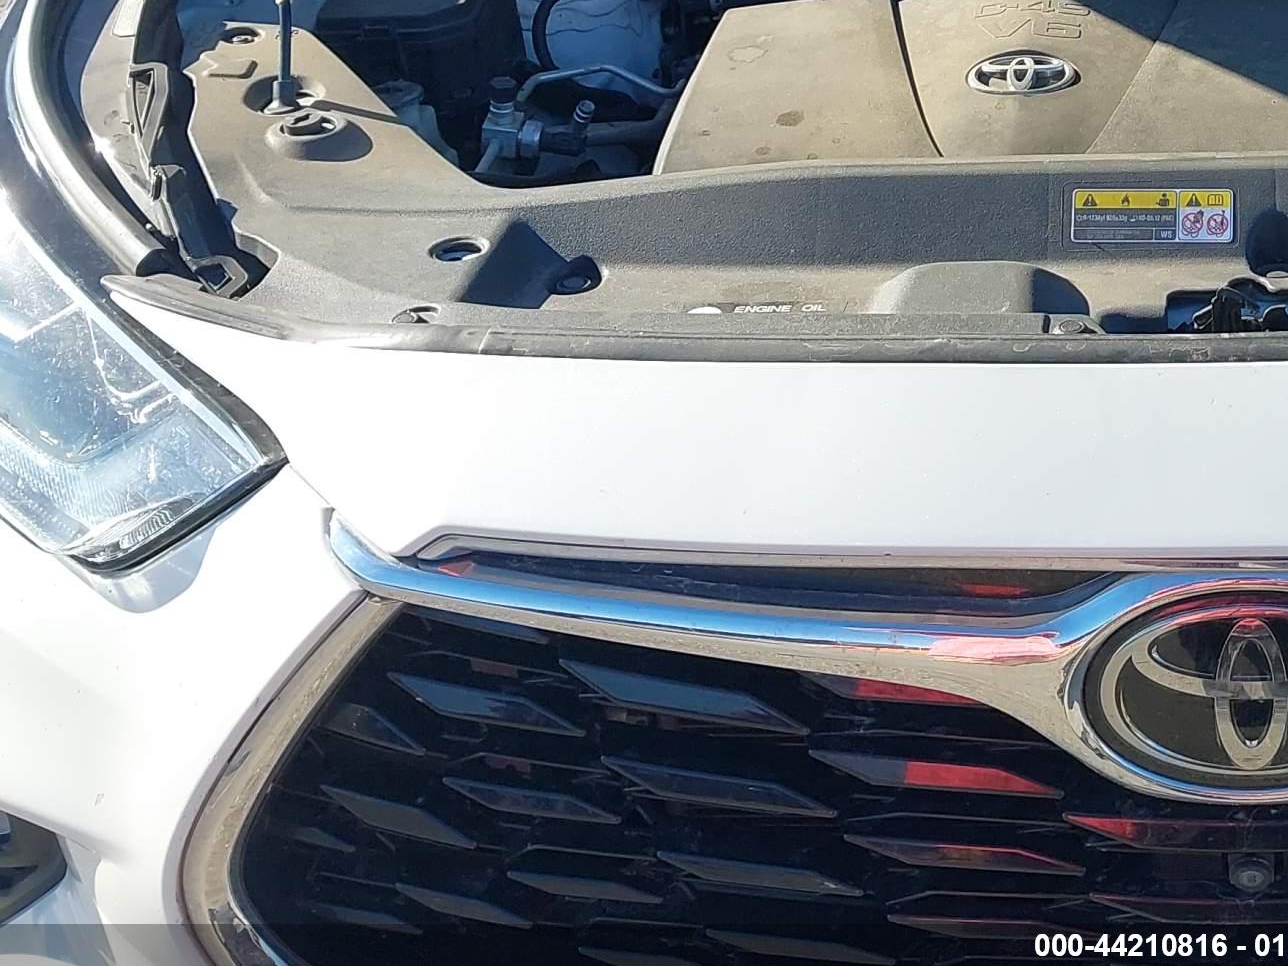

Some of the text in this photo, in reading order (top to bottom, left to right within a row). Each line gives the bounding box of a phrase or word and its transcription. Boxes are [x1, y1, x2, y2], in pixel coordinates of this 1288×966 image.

[979, 18, 1083, 39] V6
[733, 304, 827, 314] ENGINE OIL
